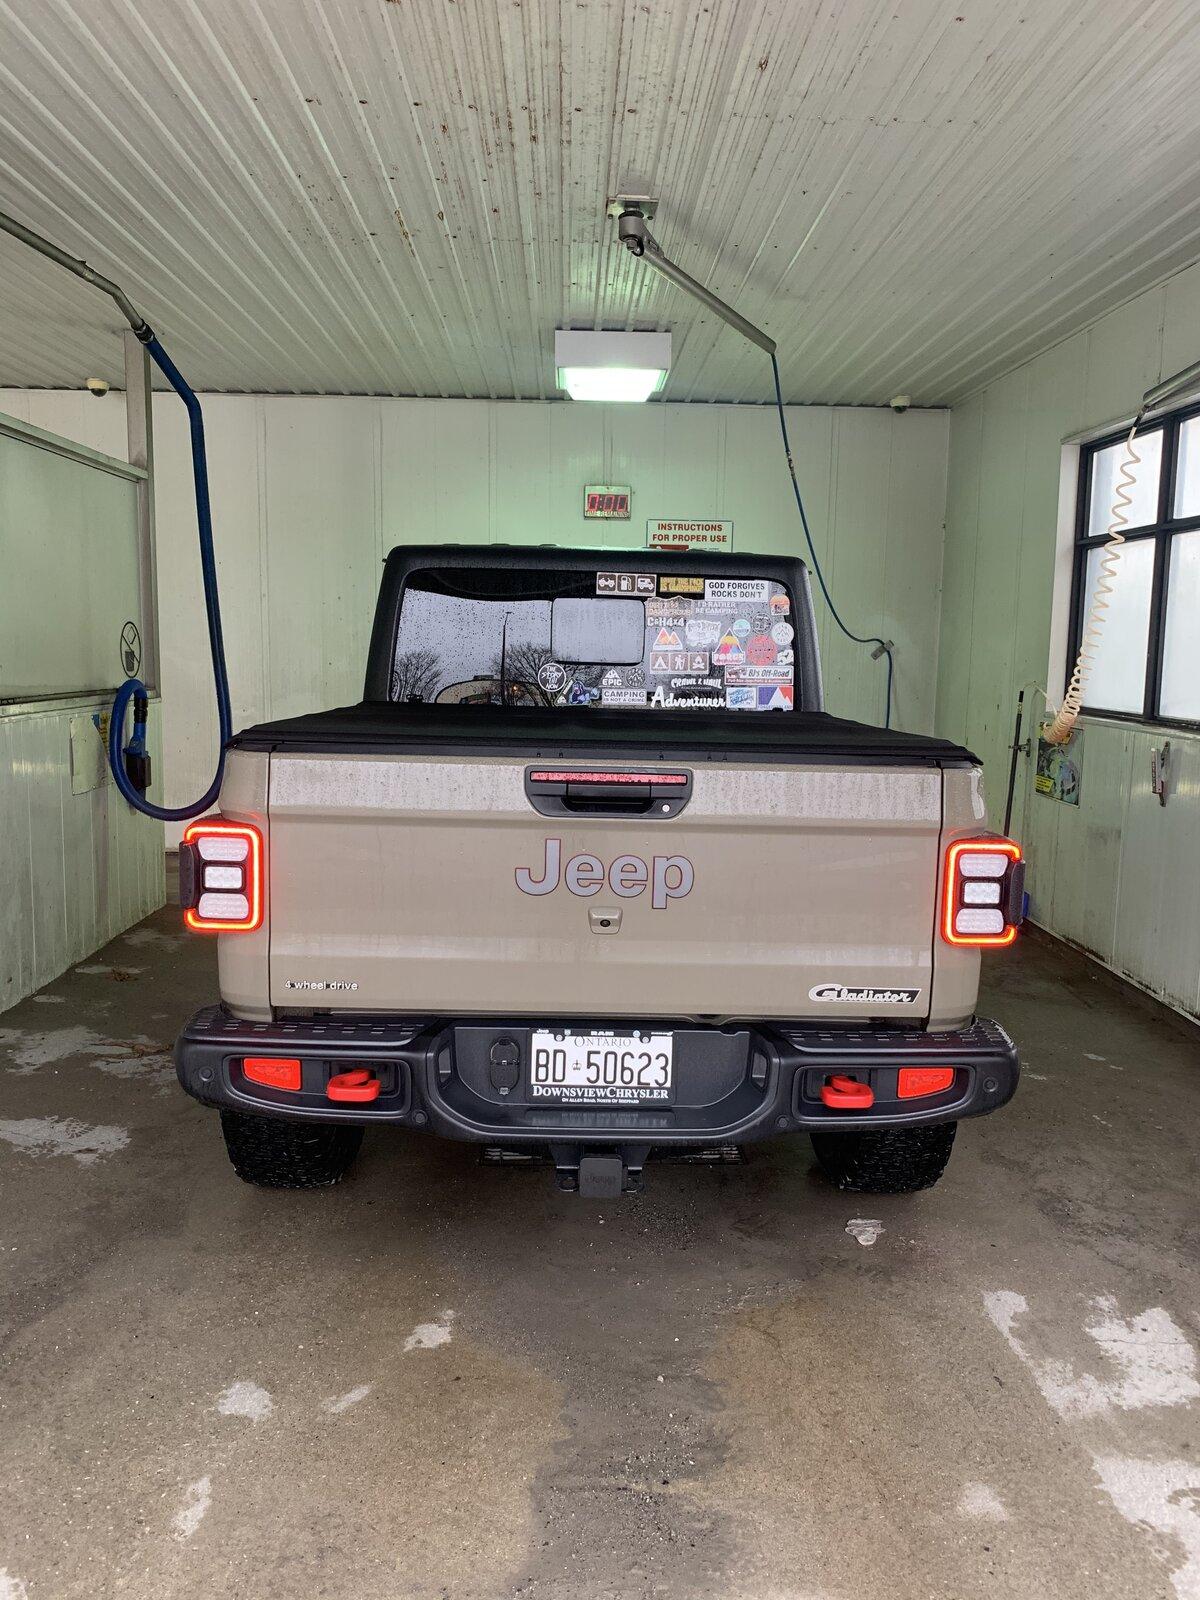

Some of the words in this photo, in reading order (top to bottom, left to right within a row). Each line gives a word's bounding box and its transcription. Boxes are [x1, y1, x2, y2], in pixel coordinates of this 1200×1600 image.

[588, 494, 628, 512] 0:00
[657, 523, 723, 532] INSTRUCTIONS
[652, 534, 670, 542] FOR
[672, 534, 708, 543] PROPER
[709, 535, 727, 543] USE
[708, 581, 726, 589] GOD
[727, 582, 765, 590] FORGIVES
[711, 590, 738, 598] ROCKS
[740, 590, 762, 598] DON'T
[761, 668, 790, 677] Off-Road
[602, 678, 622, 686] EPIC
[603, 690, 645, 698] CAMPING
[651, 685, 726, 708] Adventurer
[514, 838, 695, 910] Jeep
[294, 980, 327, 990] wheel
[329, 980, 359, 990] drive
[808, 983, 912, 1002] Gladiator
[574, 1036, 632, 1048] ONTARIO
[535, 1049, 567, 1083] BD
[586, 1050, 669, 1087] 50623
